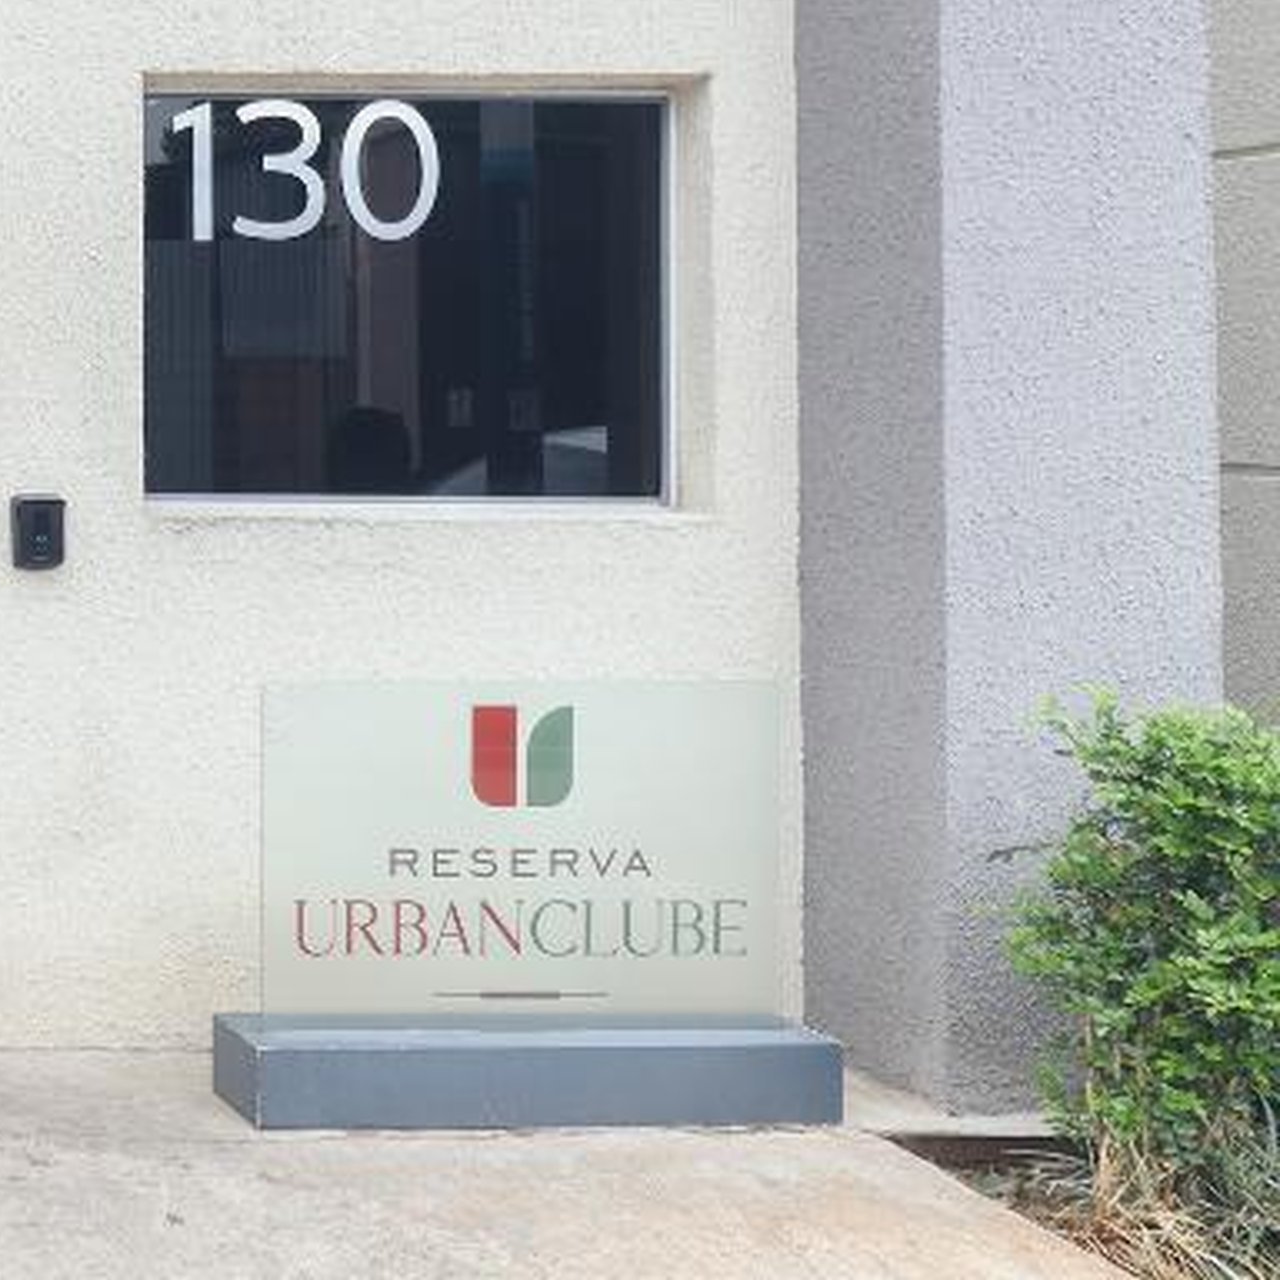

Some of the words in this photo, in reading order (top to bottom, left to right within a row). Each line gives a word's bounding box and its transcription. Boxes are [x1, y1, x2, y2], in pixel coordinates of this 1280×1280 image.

[172, 100, 440, 241] 130
[388, 848, 652, 877] RESERVA
[295, 899, 748, 957] URBANCLUBE
